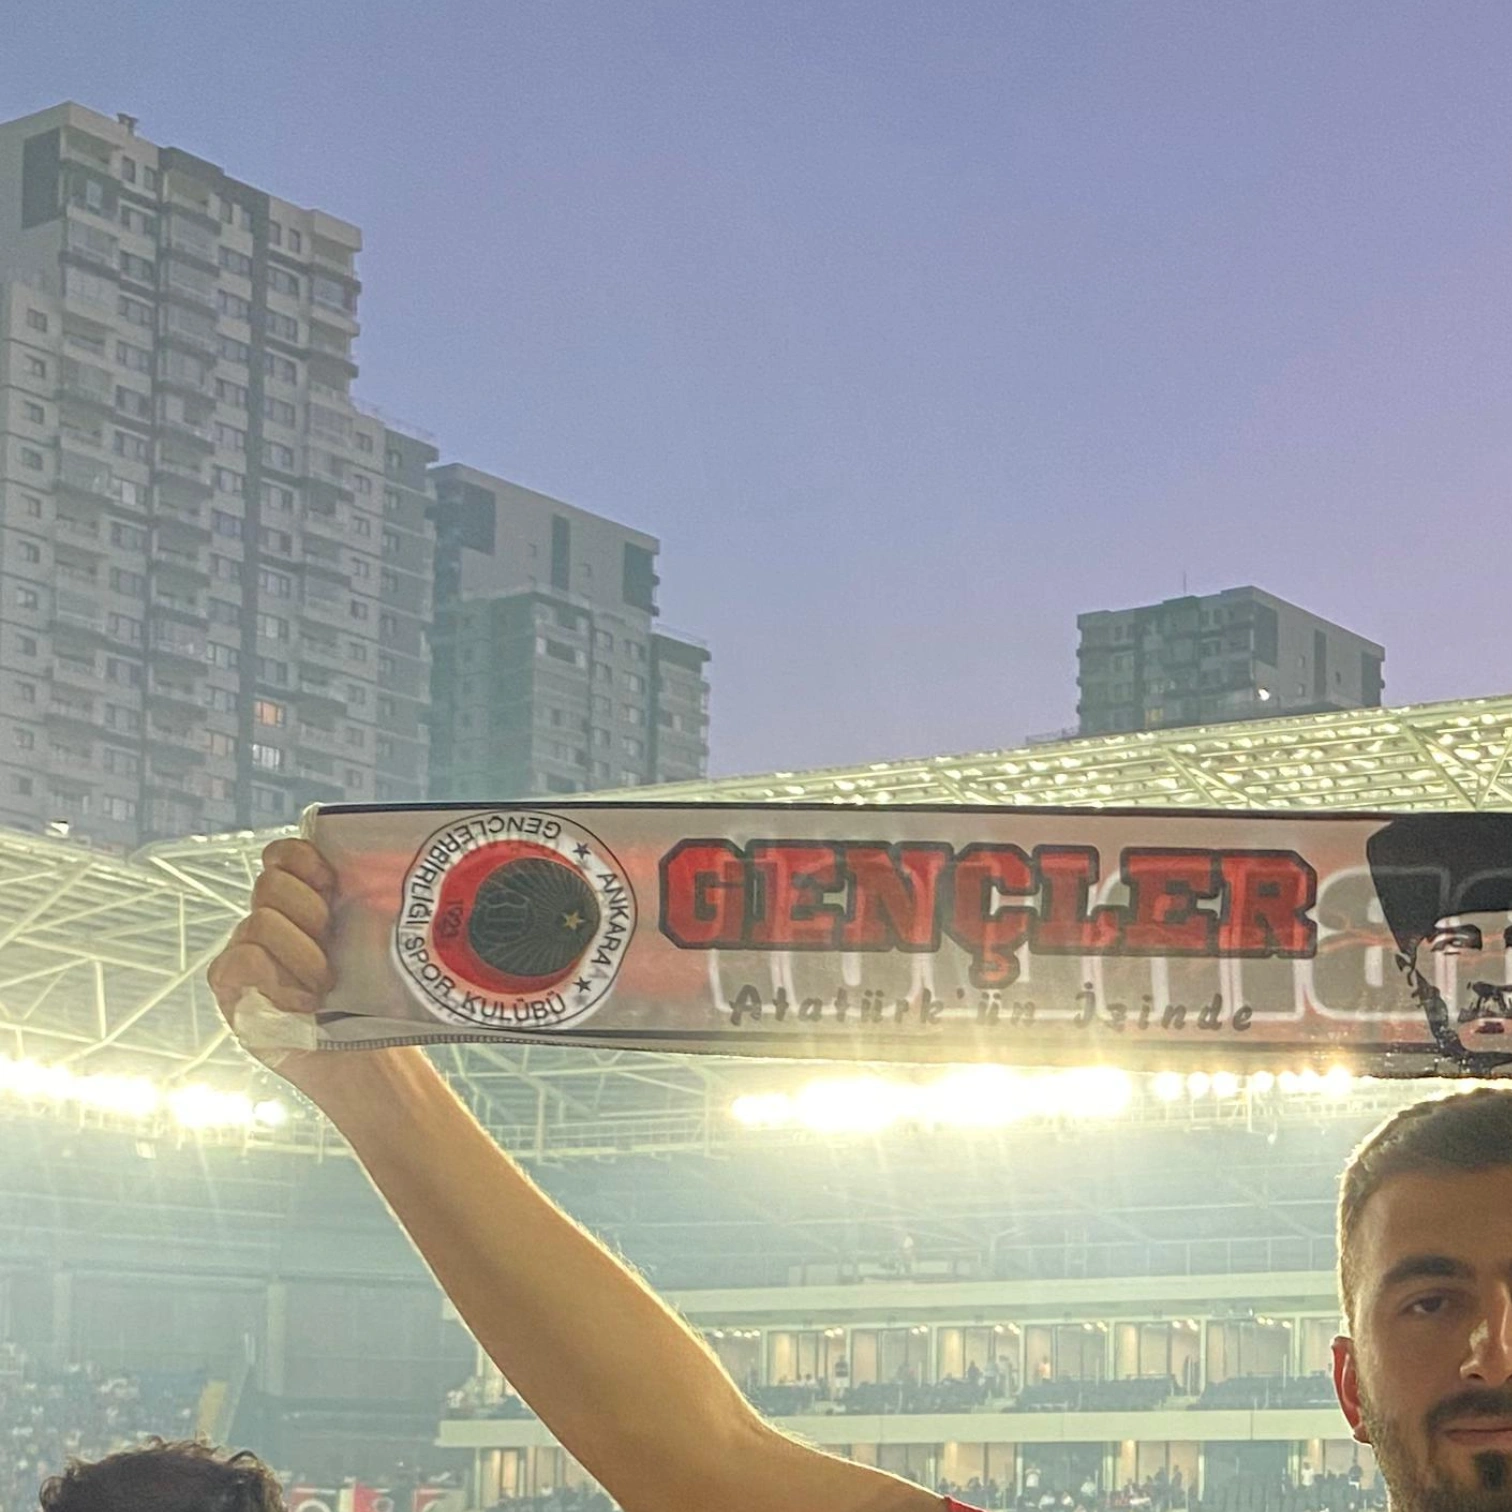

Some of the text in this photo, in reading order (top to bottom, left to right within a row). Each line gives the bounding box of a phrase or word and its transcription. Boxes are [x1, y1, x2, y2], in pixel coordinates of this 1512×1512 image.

[591, 872, 630, 968] ANKARA
[659, 838, 1318, 989] GENÇLER
[404, 935, 456, 999] SPOR
